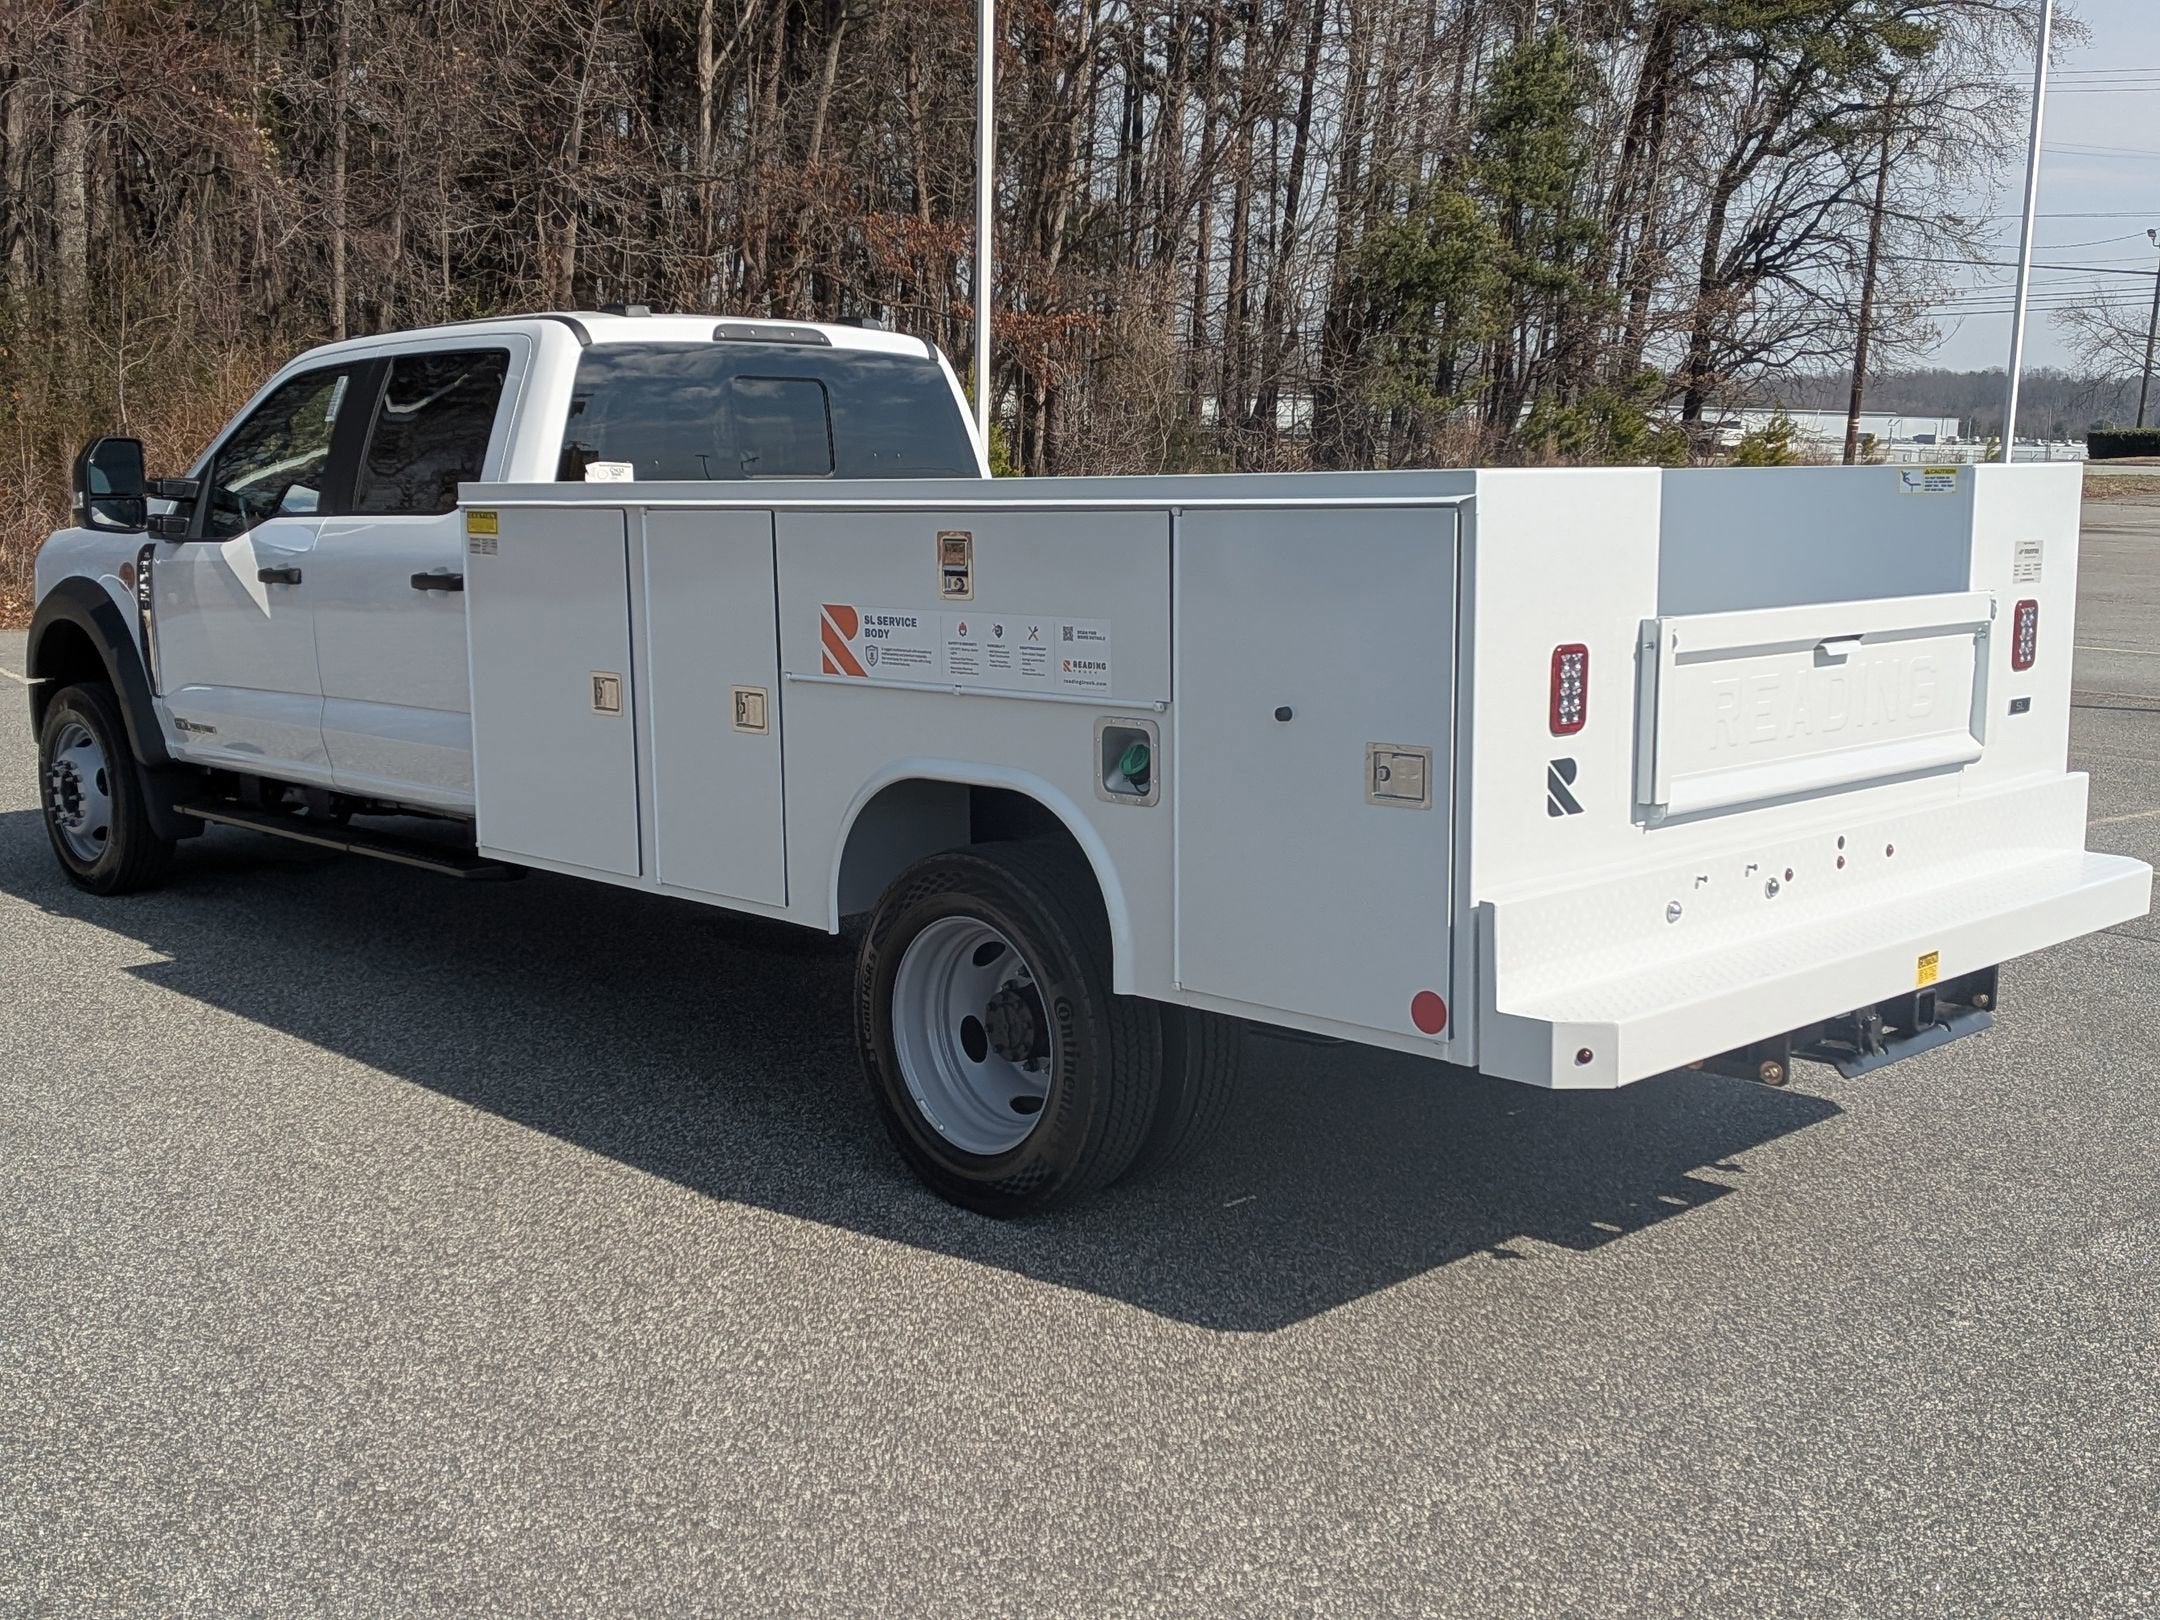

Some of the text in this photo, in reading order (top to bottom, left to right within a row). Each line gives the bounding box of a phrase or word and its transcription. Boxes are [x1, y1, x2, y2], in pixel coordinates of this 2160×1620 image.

[864, 615, 917, 628] SL SERVICE
[864, 628, 890, 639] BODY
[1073, 660, 1107, 670] READING
[1709, 656, 1937, 750] READING
